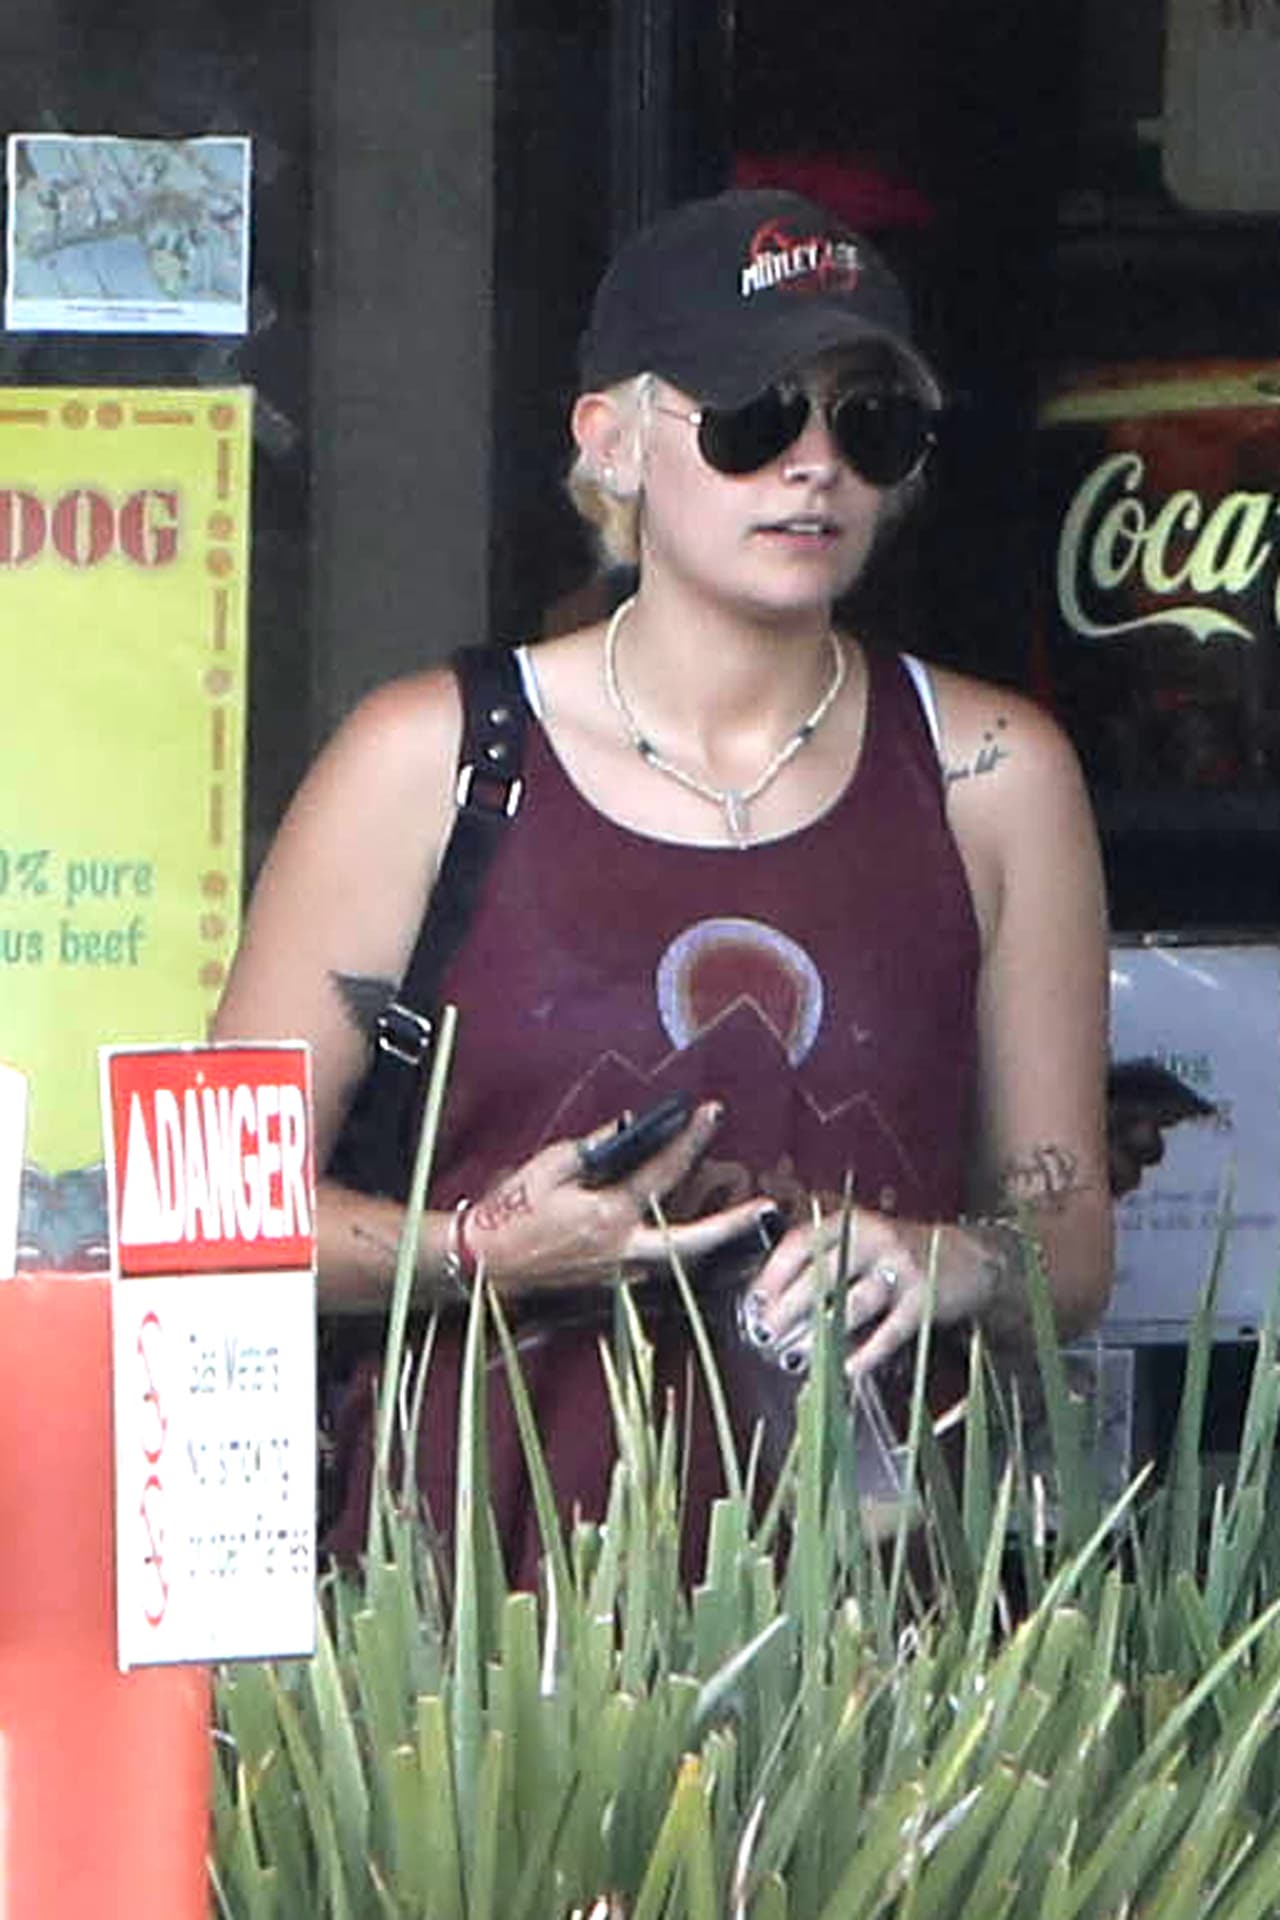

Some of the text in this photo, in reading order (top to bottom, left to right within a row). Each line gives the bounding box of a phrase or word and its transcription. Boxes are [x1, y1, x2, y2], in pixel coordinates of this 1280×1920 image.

[0, 489, 178, 568] DOG
[1057, 453, 1273, 641] Coca
[66, 858, 154, 907] pure
[59, 915, 146, 966] beef
[154, 1083, 312, 1243] DANGER
